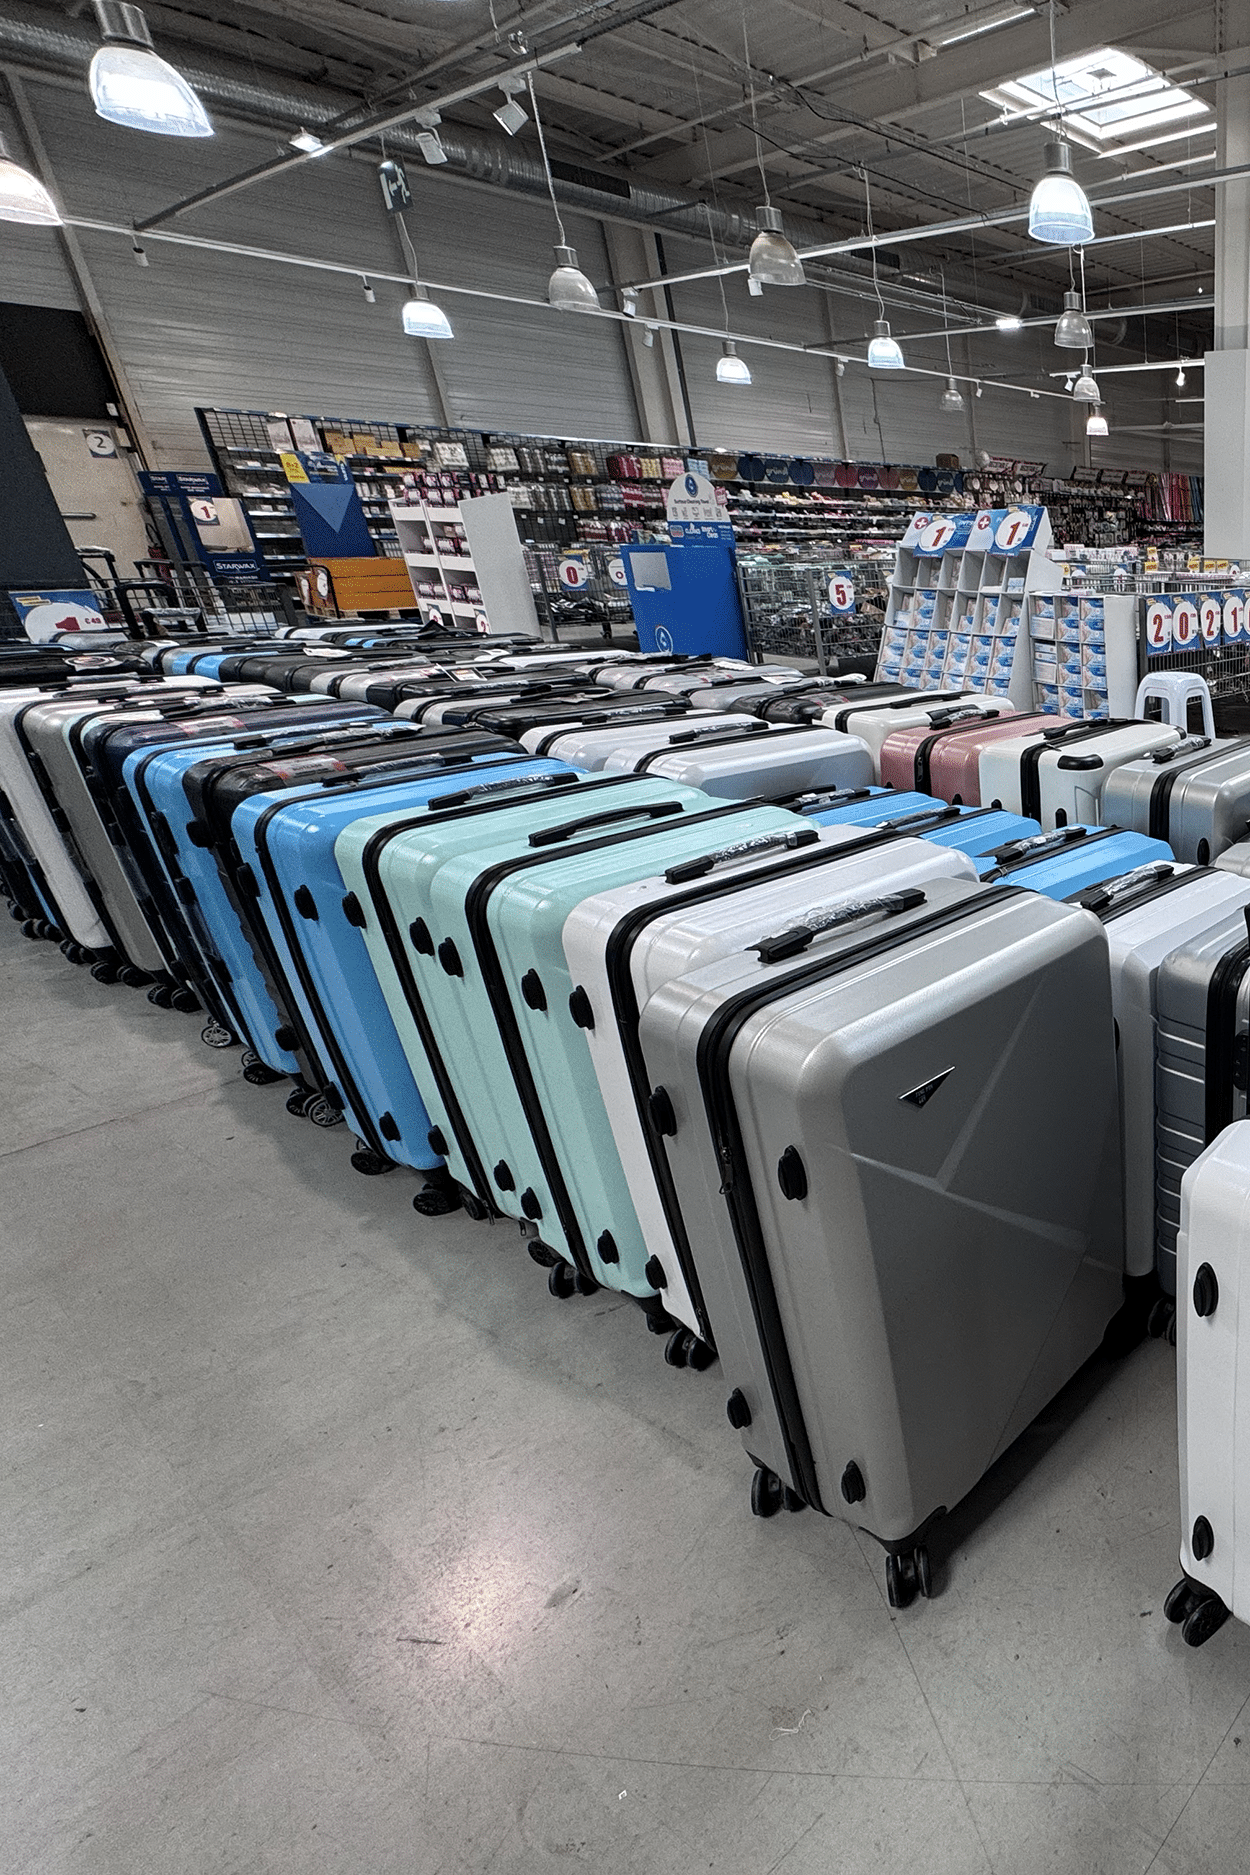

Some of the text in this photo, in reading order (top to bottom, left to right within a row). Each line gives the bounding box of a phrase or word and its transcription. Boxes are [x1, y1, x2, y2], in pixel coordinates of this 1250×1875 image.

[94, 436, 106, 448] 2
[200, 505, 211, 519] 1
[932, 526, 947, 547] 1
[1006, 521, 1021, 546] 1
[216, 562, 257, 571] STARWAX
[566, 566, 579, 585] 0
[835, 584, 847, 606] 5
[1153, 614, 1164, 642] 2
[1179, 612, 1189, 640] 0
[1206, 609, 1214, 636] 2
[1231, 607, 1238, 633] 1
